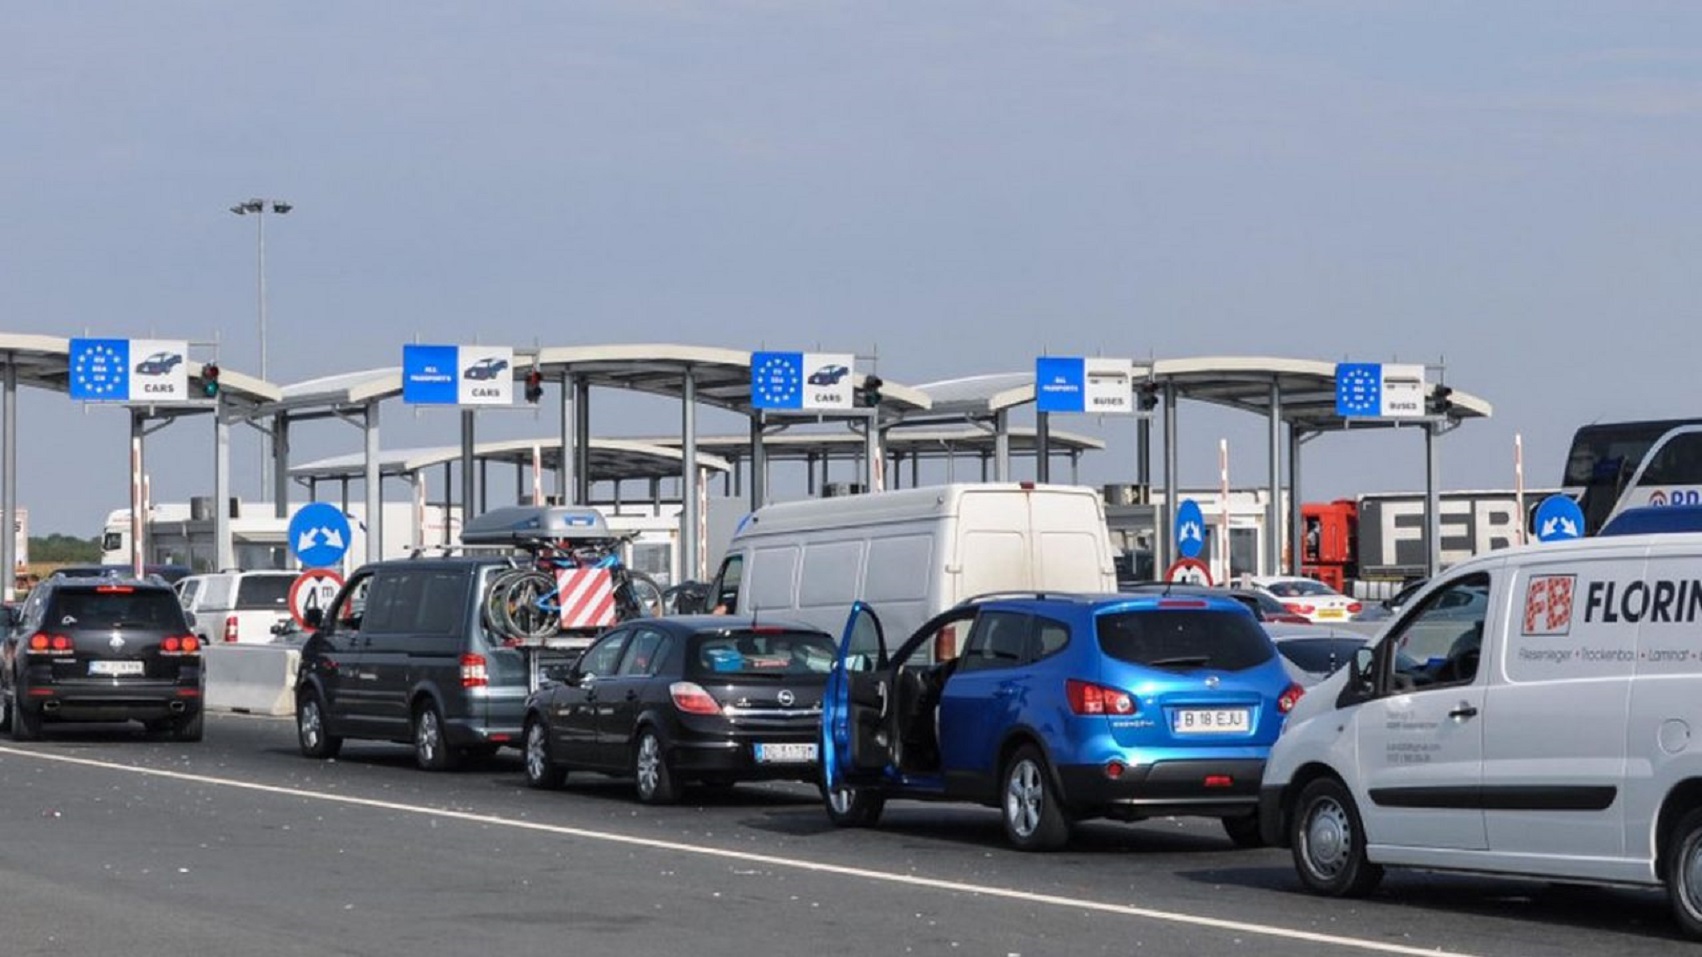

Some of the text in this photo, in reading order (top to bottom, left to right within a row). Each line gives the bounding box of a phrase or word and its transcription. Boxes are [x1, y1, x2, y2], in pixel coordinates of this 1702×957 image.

[144, 383, 174, 393] CARS
[471, 387, 500, 397] CARS
[814, 393, 842, 403] CARS
[1524, 577, 1571, 632] FB
[1184, 712, 1242, 727] B 18 EJU
